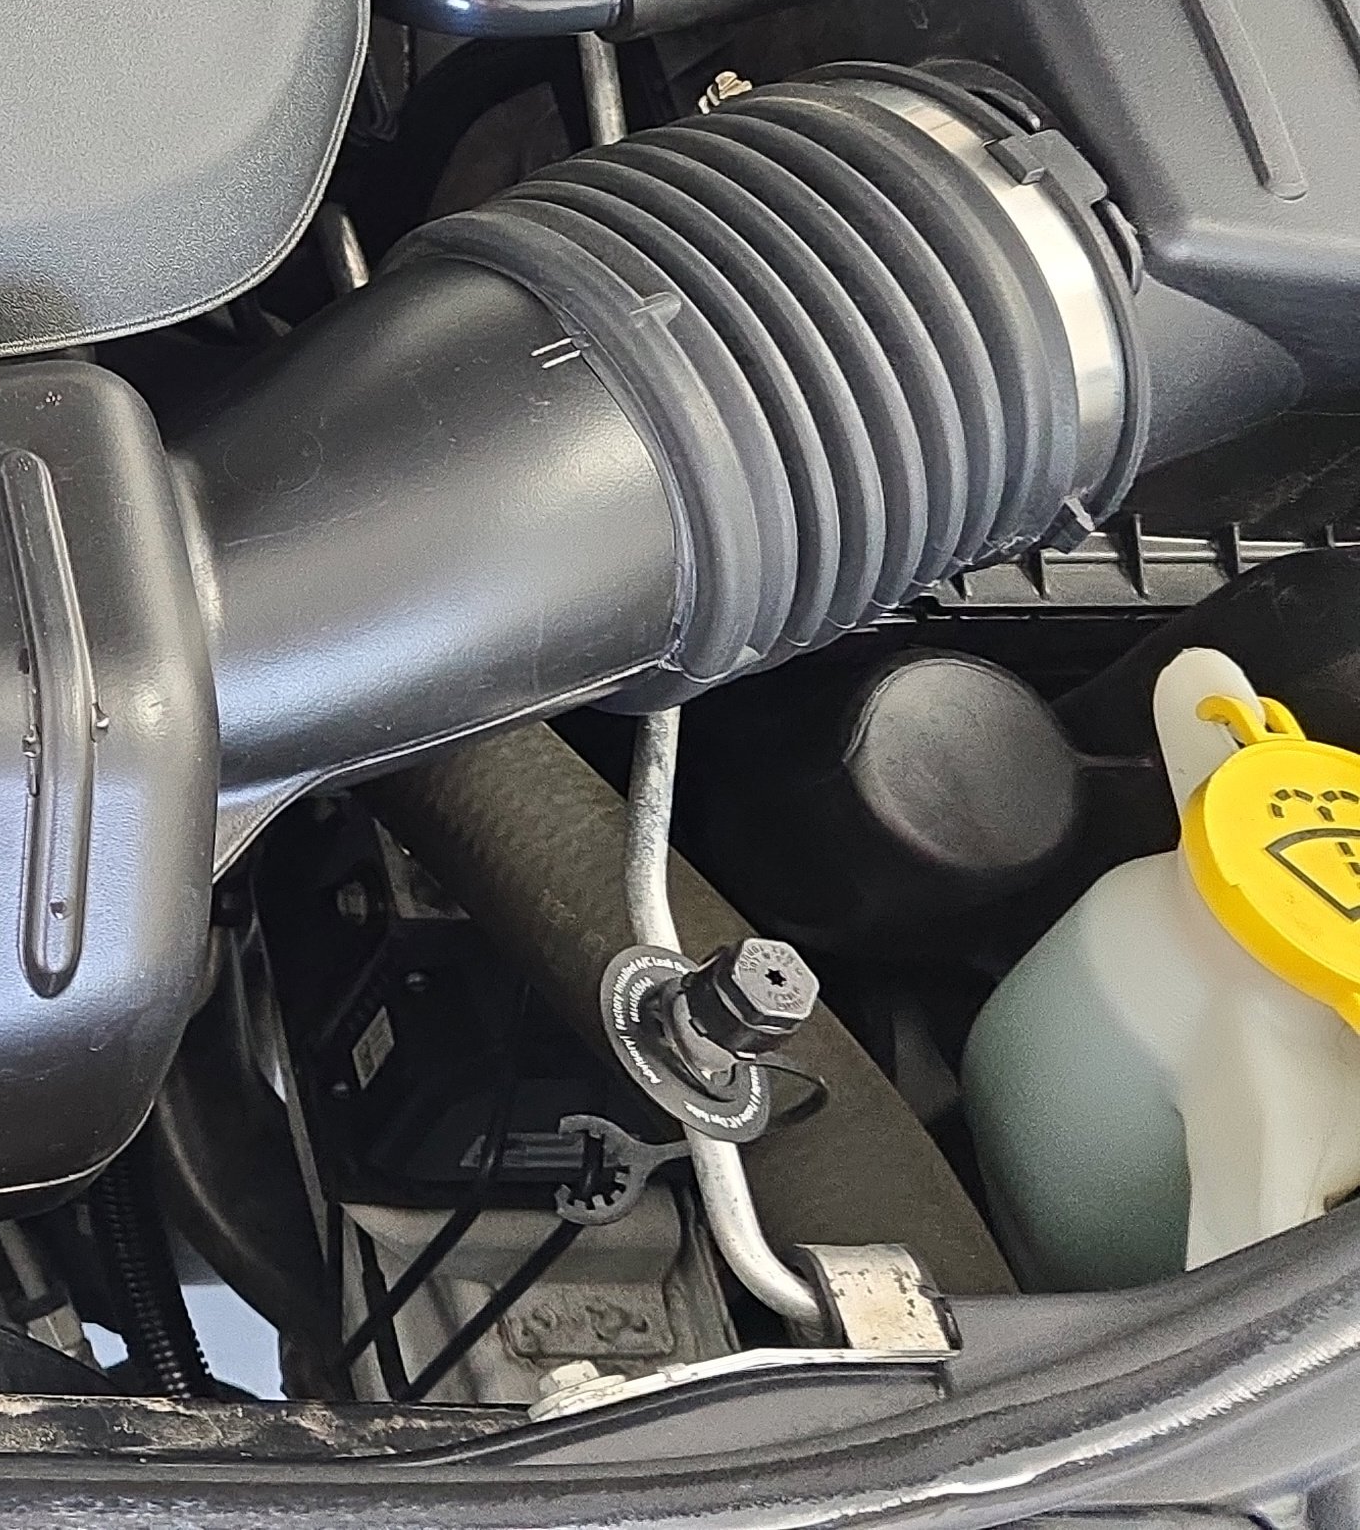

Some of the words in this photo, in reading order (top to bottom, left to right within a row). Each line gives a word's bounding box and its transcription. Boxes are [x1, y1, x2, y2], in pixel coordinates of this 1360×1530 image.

[612, 959, 638, 993] Installed
[633, 956, 654, 970] A/C
[612, 991, 628, 1032] Factory
